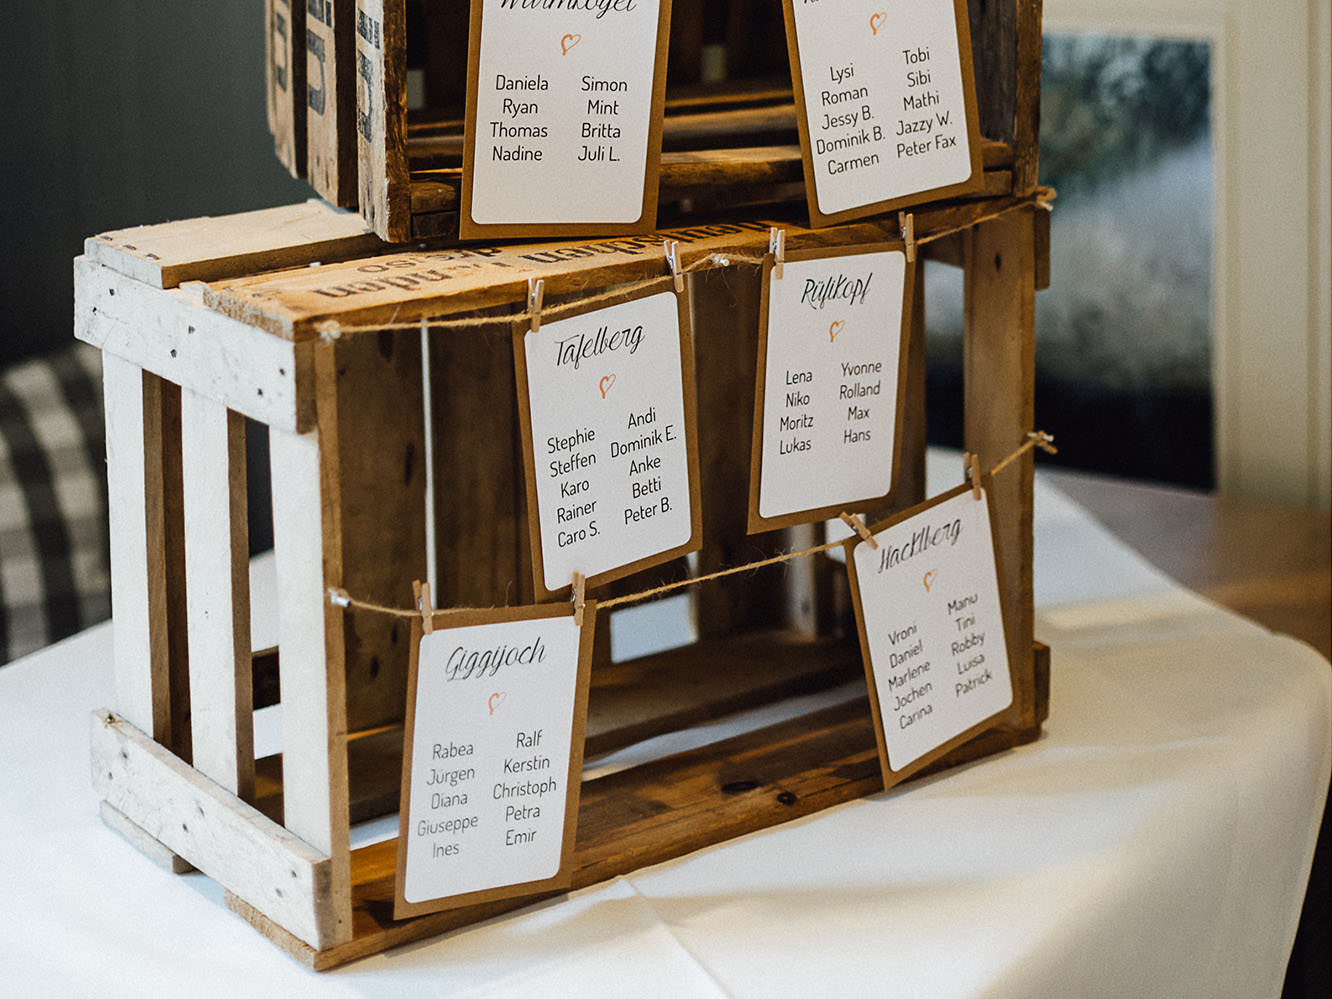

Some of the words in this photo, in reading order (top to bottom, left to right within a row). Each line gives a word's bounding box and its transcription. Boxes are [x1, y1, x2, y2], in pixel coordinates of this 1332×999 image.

[902, 47, 930, 64] Tobi
[496, 75, 548, 90] Daniela
[581, 76, 627, 91] Simon
[830, 63, 854, 84] Lysi
[907, 70, 931, 87] Sibi
[822, 88, 868, 106] Roman
[904, 91, 939, 111] Mathi
[503, 98, 538, 118] Ryan
[588, 100, 619, 115] Mint
[822, 112, 858, 130] Jessy
[862, 105, 874, 120] B.
[490, 122, 547, 137] Thomas
[582, 123, 620, 138] Britta
[896, 119, 933, 136] Jazzy
[936, 111, 952, 126] W.
[816, 129, 870, 155] Dominik
[873, 126, 885, 141] B.
[897, 141, 931, 158] Peter
[935, 134, 956, 149] Fax
[493, 145, 542, 161] Nadine
[578, 146, 604, 161] Juli
[609, 146, 620, 161] L.
[828, 154, 879, 175] Carmen
[556, 326, 645, 369] Tafelberg
[786, 371, 812, 385] Lena
[841, 362, 882, 376] Yvonne
[786, 391, 810, 407] Niko
[840, 380, 880, 400] Rolland
[628, 407, 655, 429] Andi
[780, 414, 813, 432] Moritz
[848, 406, 869, 420] Max
[548, 428, 595, 453] Stephie
[611, 429, 662, 458] Dominik
[666, 425, 676, 441] E.
[780, 437, 811, 455] Lukas
[844, 429, 871, 443] Hans
[550, 453, 596, 477] Steffen
[630, 455, 660, 478] Anke
[561, 480, 589, 498] Karo
[632, 476, 661, 499] Betti
[557, 501, 596, 524] Rainer
[625, 505, 657, 525] Peter
[661, 497, 672, 513] B.
[558, 529, 586, 547] Caro
[589, 521, 600, 536] S.
[877, 518, 962, 574] Hacklberg
[948, 594, 978, 615] Manu
[888, 625, 917, 645] Vroni
[951, 632, 985, 656] Robby
[890, 639, 923, 668] Daniel
[888, 662, 930, 691] Marlene
[955, 669, 992, 697] Patrick
[894, 683, 932, 711] Jochen
[517, 729, 542, 748] Ralf
[433, 742, 473, 760] Rabea
[504, 755, 550, 773] Kerstin
[493, 776, 556, 799] Christoph
[432, 793, 467, 809] Diana
[506, 805, 540, 822] Petra
[418, 816, 478, 836] Giuseppe
[506, 829, 536, 846] Emir
[433, 843, 459, 858] Ines
